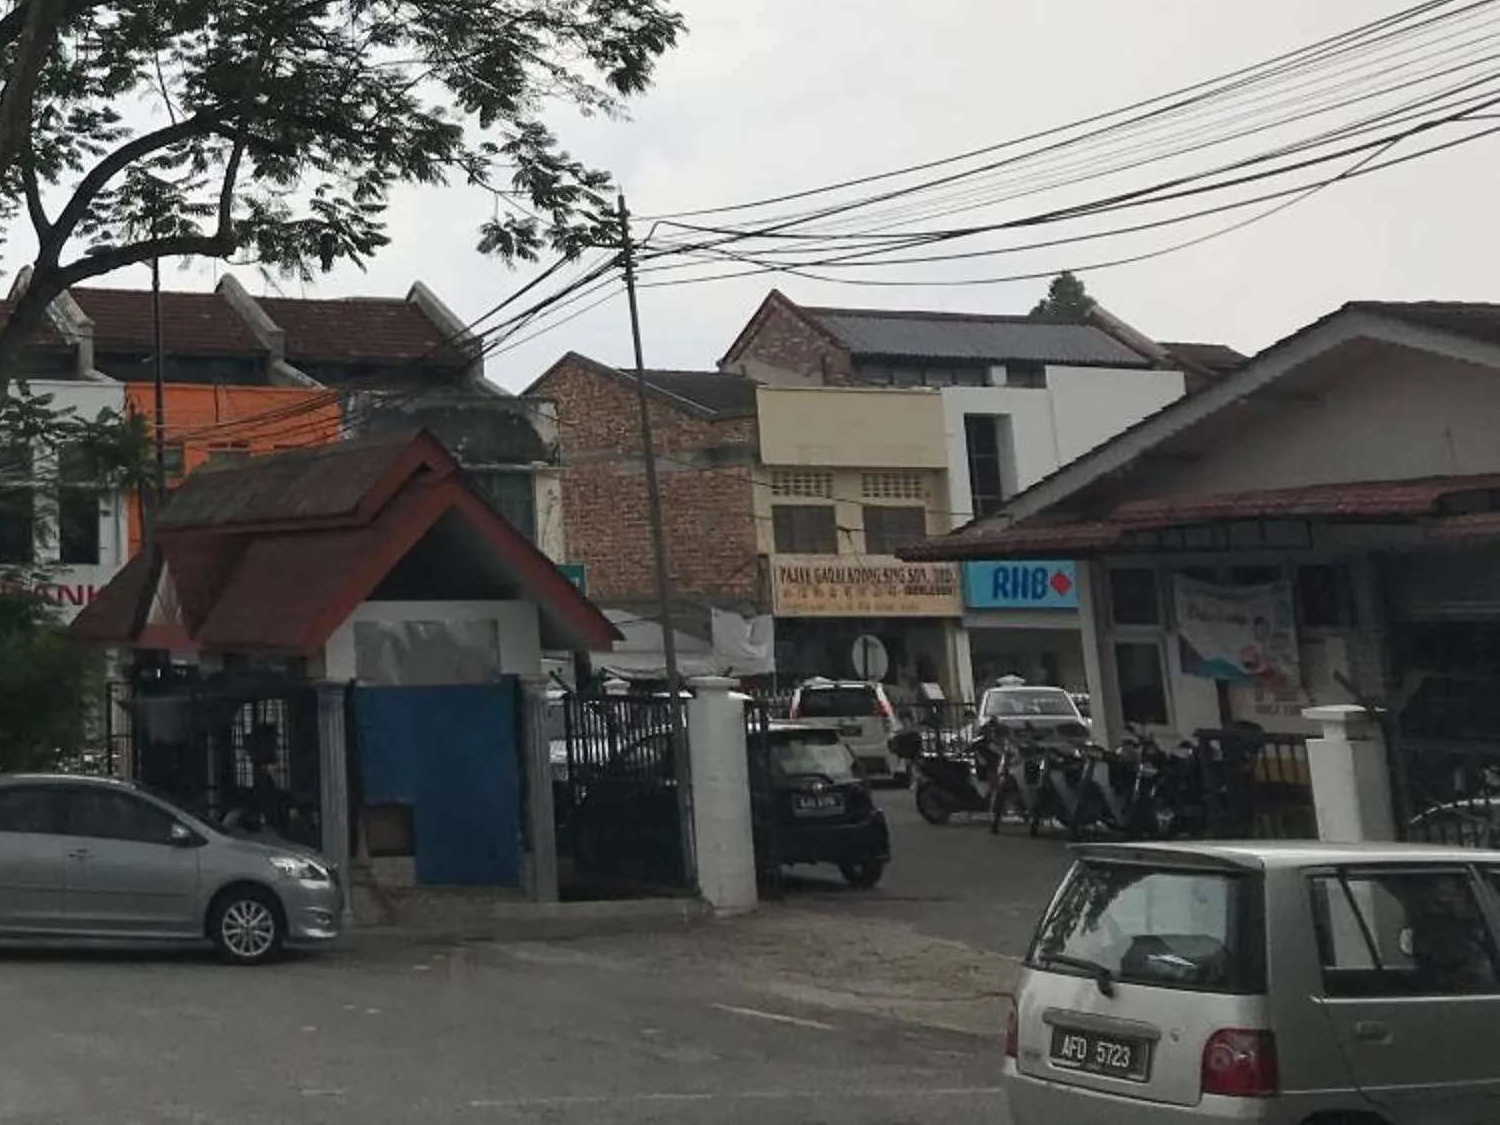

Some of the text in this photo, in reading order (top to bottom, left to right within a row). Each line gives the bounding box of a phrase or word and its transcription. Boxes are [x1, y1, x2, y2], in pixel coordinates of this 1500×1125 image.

[993, 566, 1048, 600] RHB
[1061, 1035, 1131, 1068] AFD 5723
